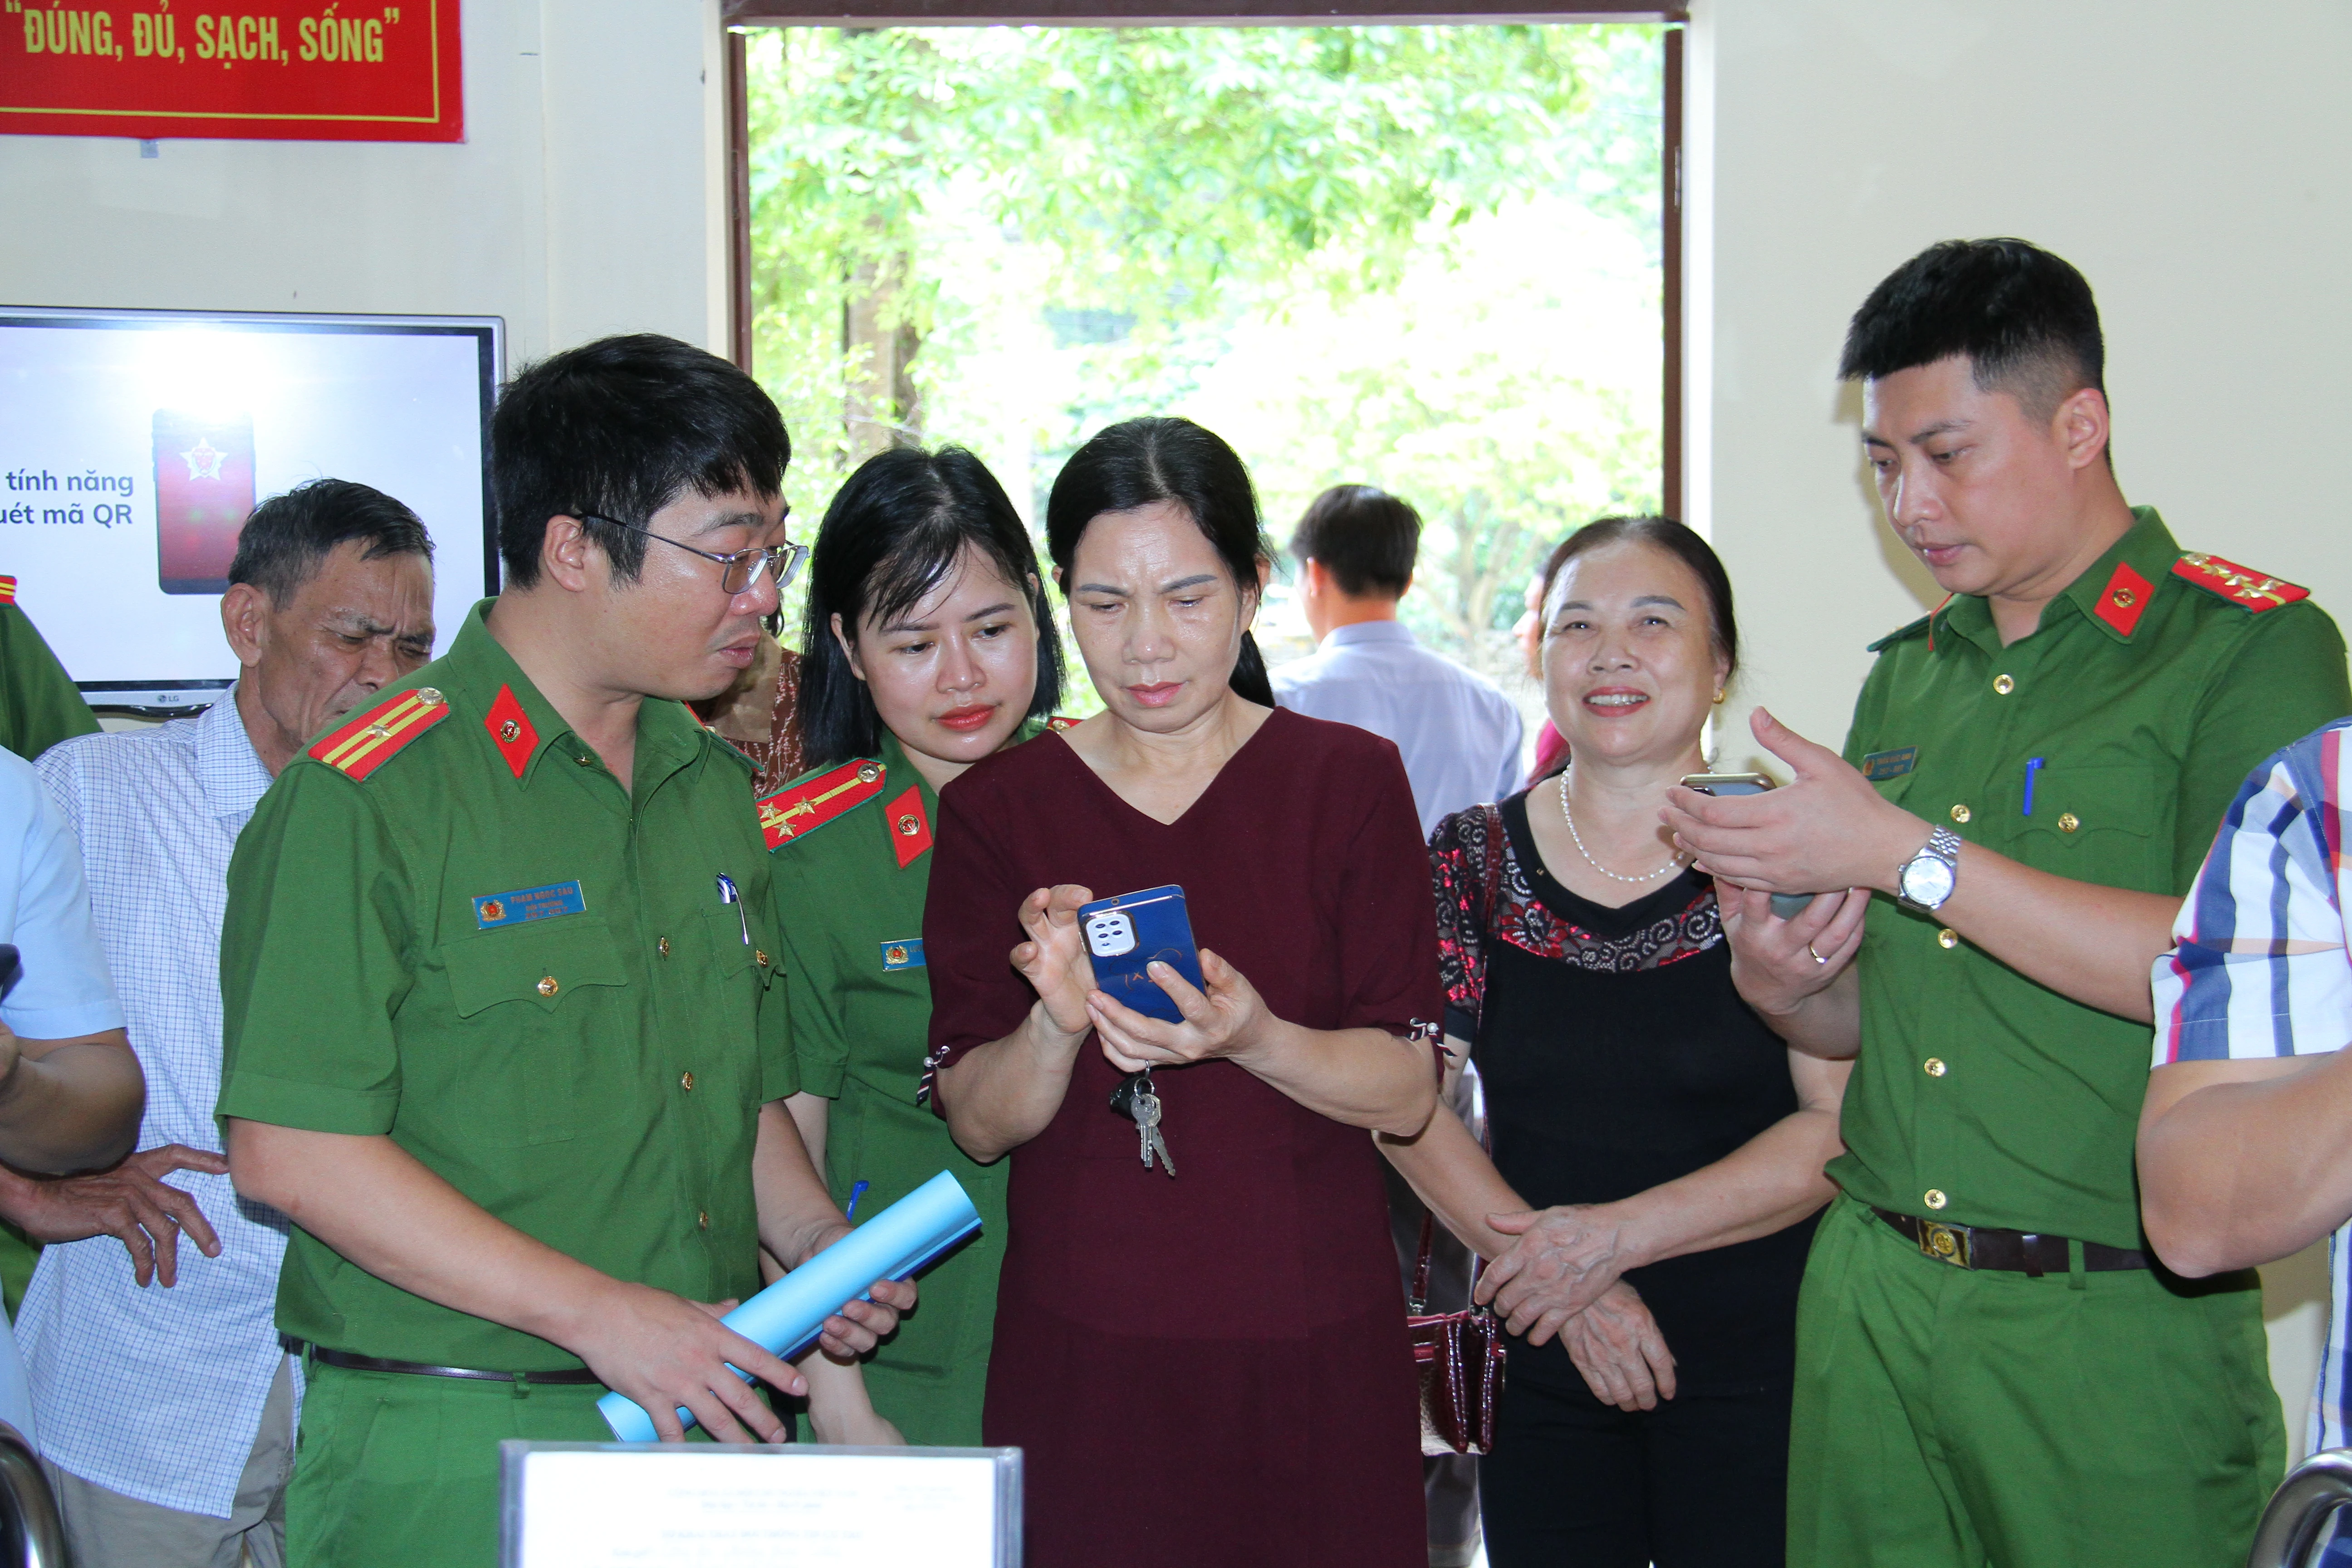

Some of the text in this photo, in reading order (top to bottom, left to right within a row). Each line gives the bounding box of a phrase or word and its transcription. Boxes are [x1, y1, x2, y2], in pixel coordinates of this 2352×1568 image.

[132, 0, 185, 64] ĐỦ,
[196, 14, 289, 69] SẠCH,
[299, 2, 400, 63] SỐNG”
[5, 468, 133, 497] tính năng
[43, 503, 84, 524] mã
[93, 504, 133, 529] QR
